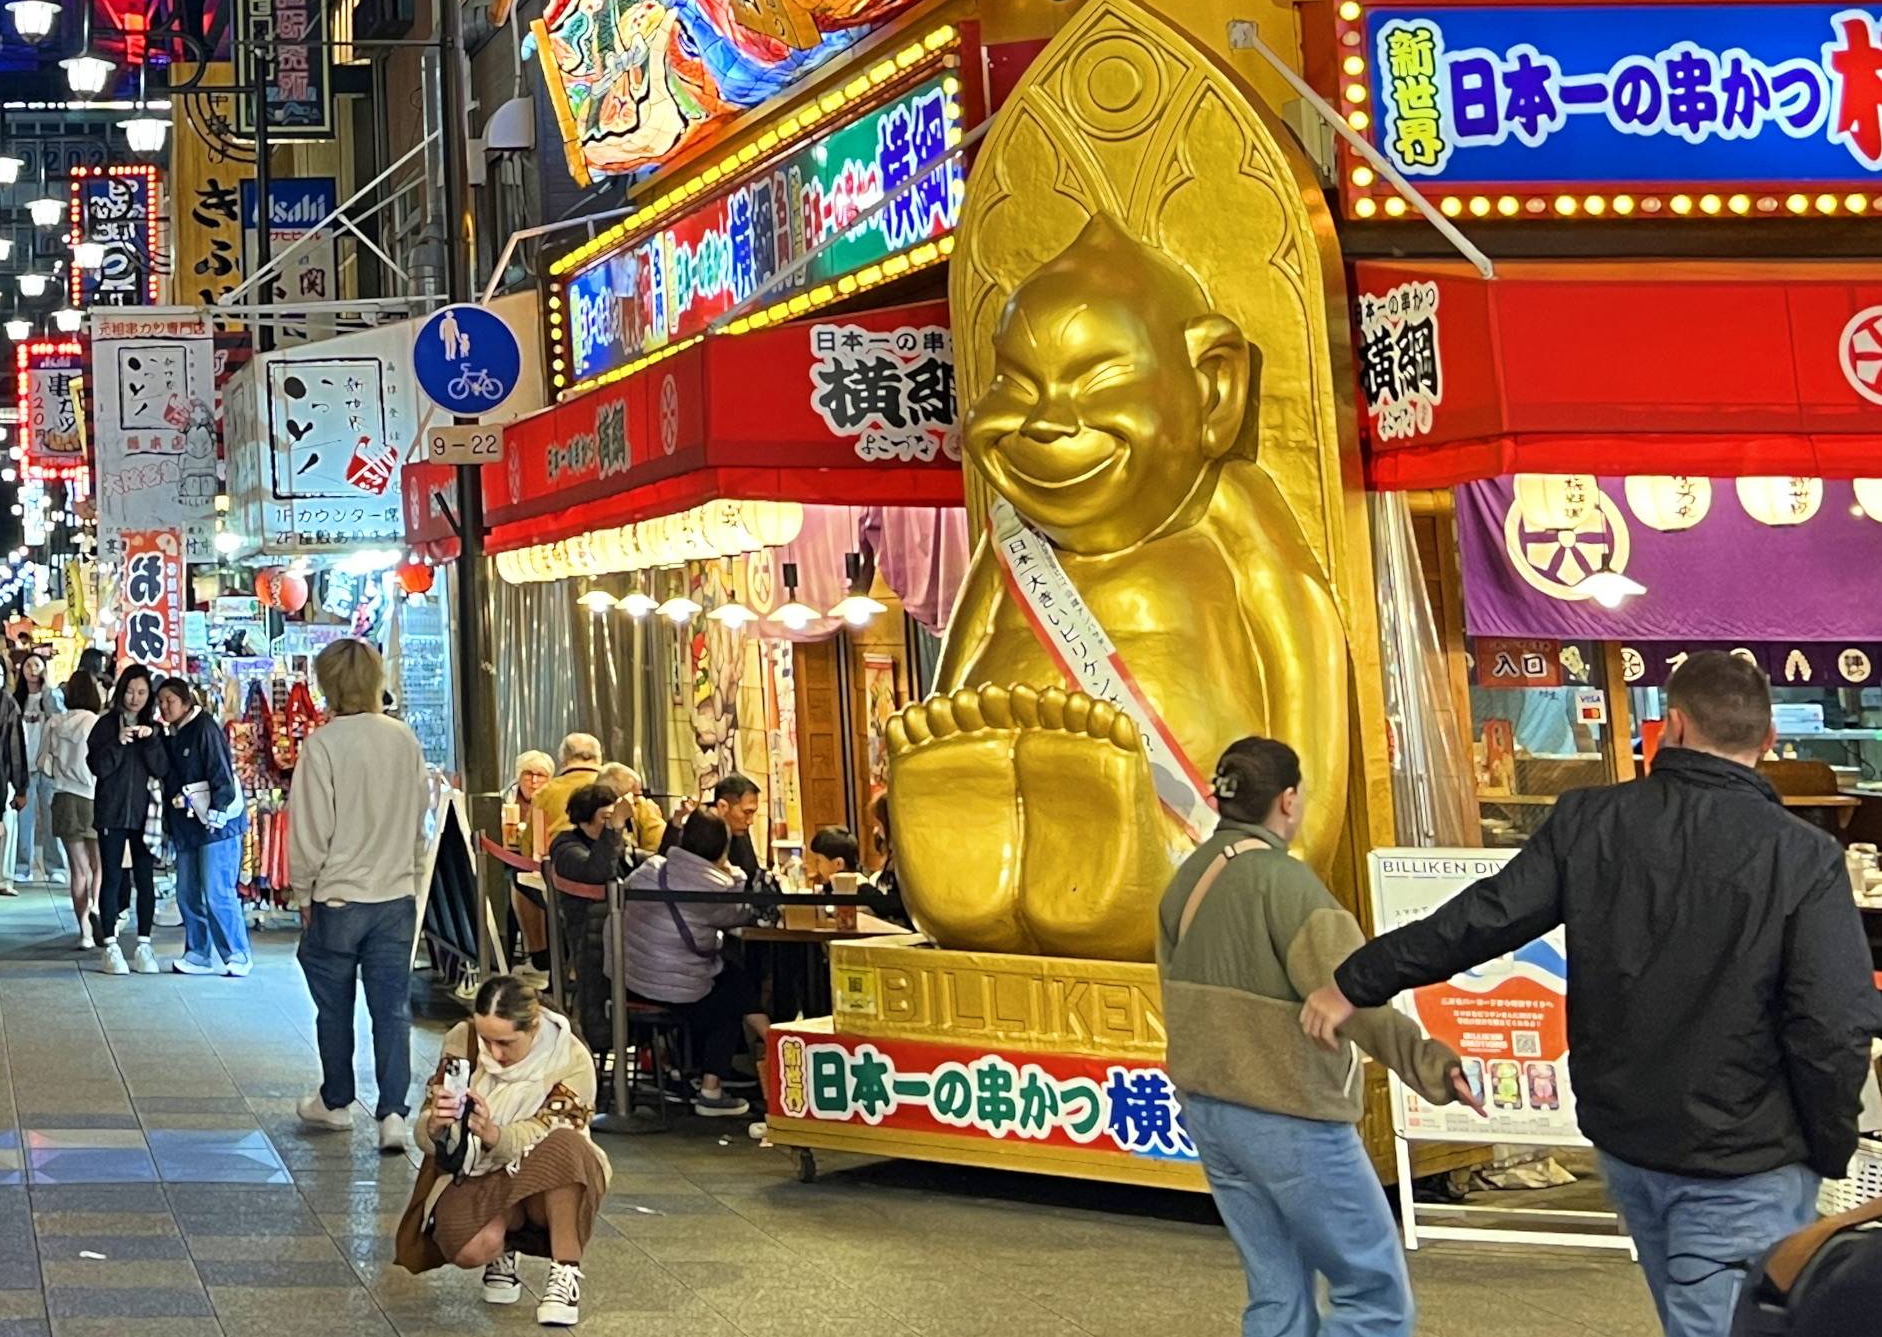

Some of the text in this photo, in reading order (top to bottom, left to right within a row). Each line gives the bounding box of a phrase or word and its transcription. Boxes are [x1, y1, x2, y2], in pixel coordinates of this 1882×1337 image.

[1386, 27, 1446, 168] 新世界
[1449, 50, 1821, 138] 日本一の串かつ
[816, 330, 954, 354] 日本一の串
[1493, 652, 1548, 677] 入口
[1383, 861, 1467, 875] BILLIKEN
[876, 966, 1166, 1043] BILLIKEN
[811, 1049, 1100, 1136] 日本一の串かつ
[1107, 1069, 1196, 1152] 横
